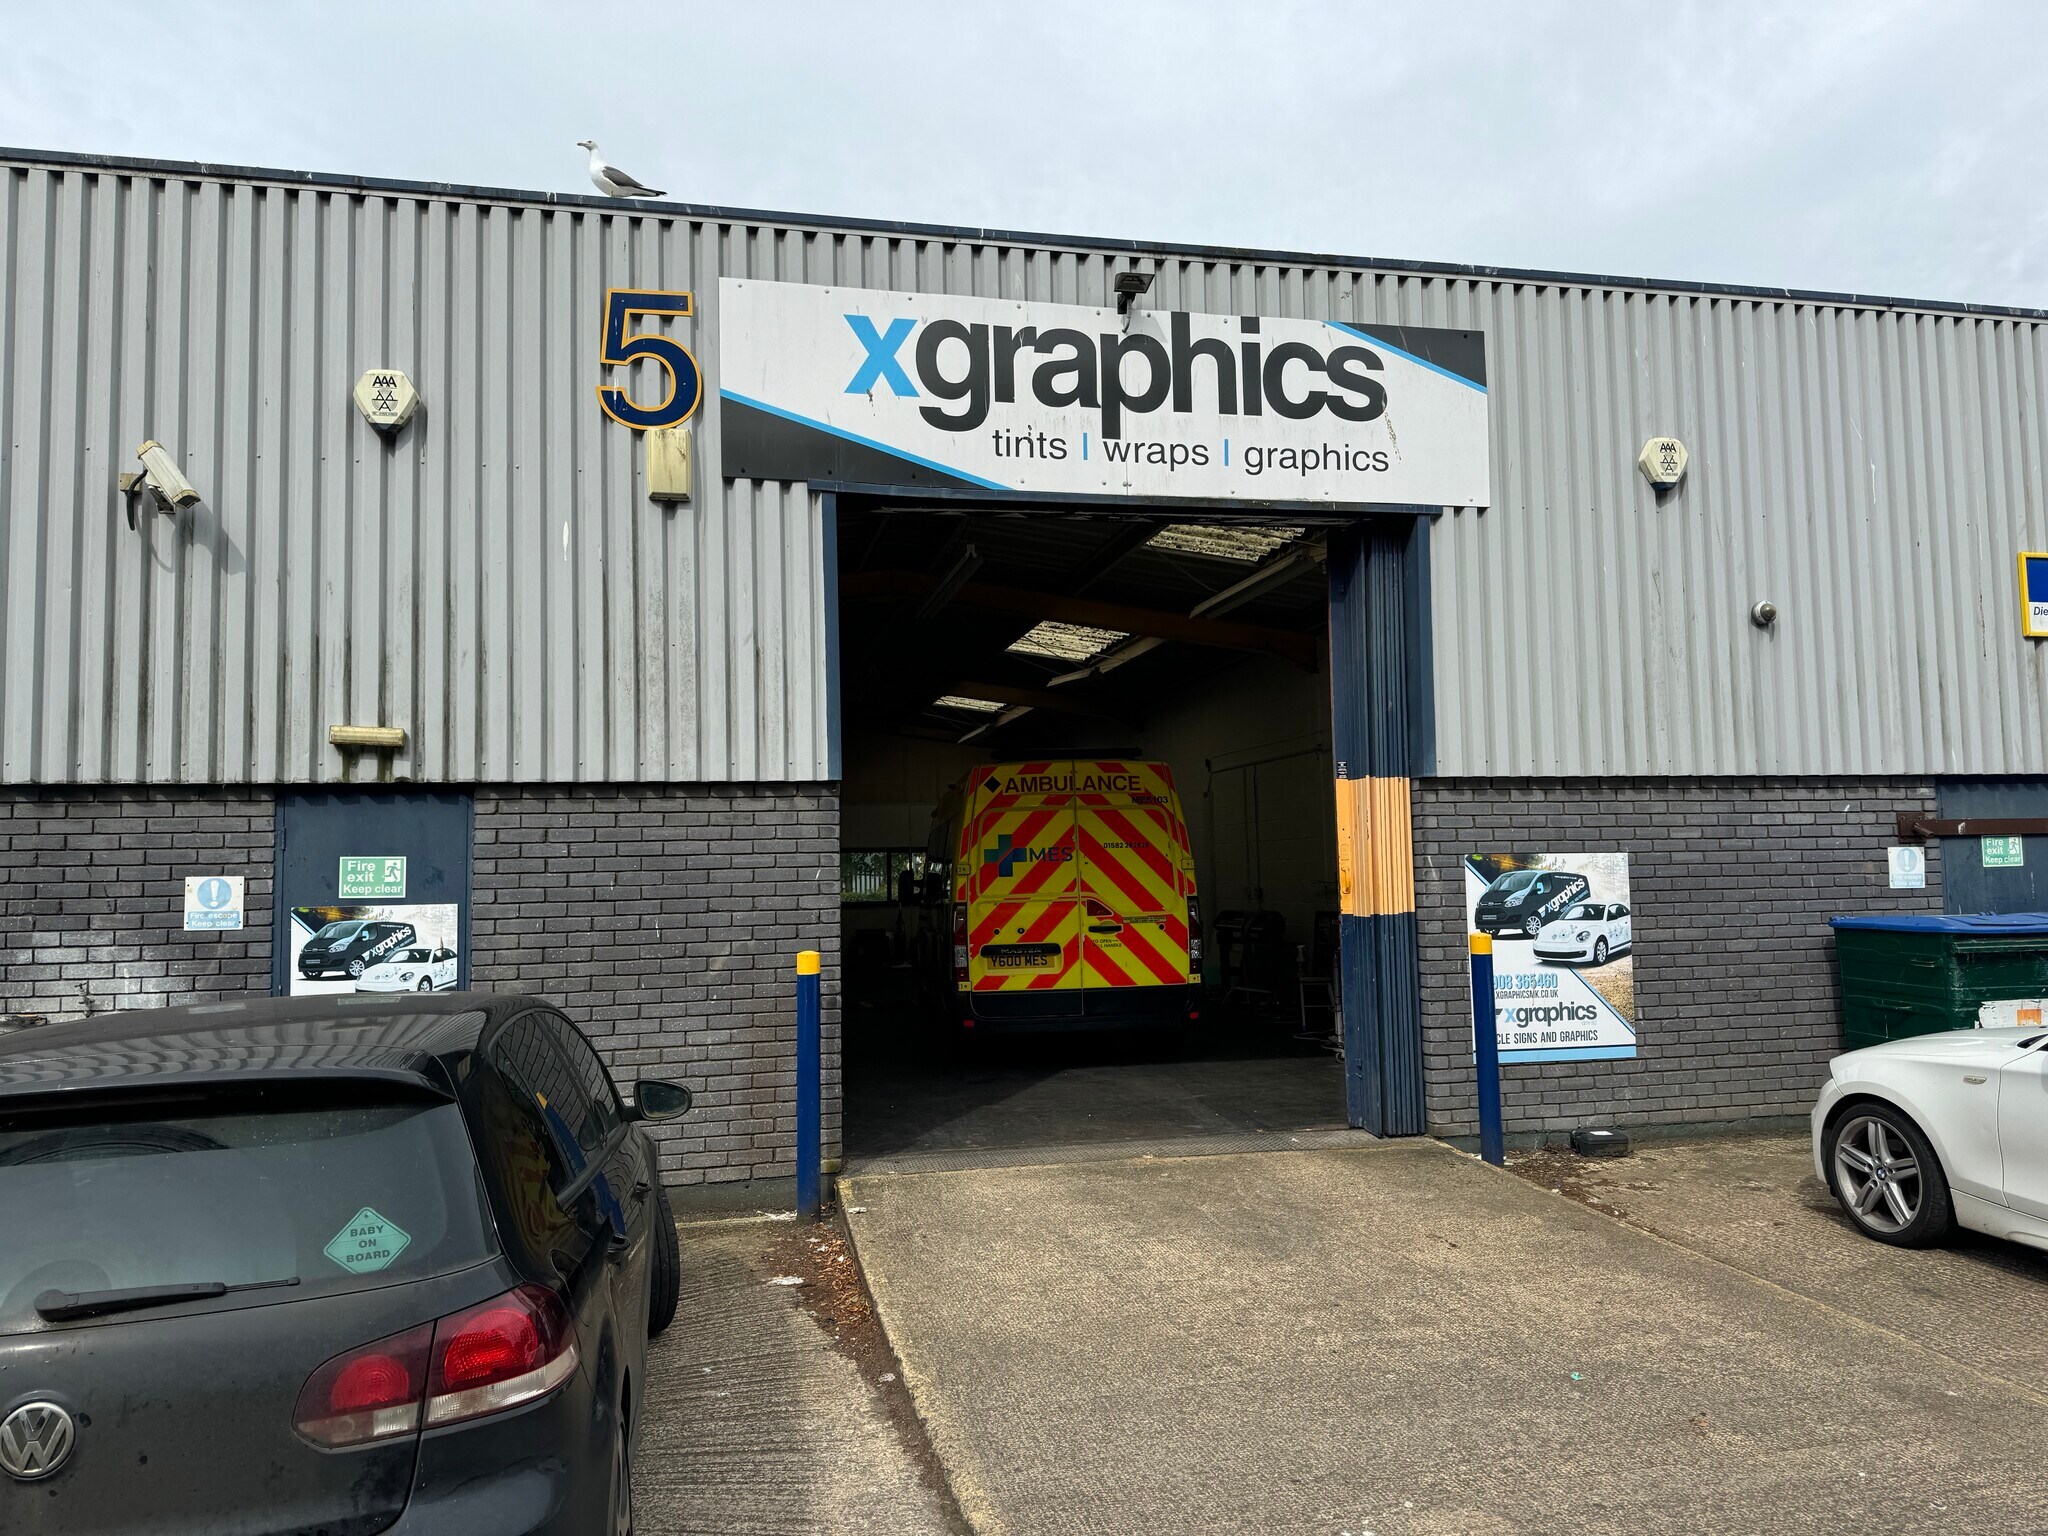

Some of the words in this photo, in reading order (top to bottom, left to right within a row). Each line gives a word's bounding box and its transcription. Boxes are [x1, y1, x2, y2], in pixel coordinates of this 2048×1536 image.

[595, 288, 702, 430] 5
[372, 375, 397, 388] AAA
[843, 311, 1388, 440] xgraphics
[992, 429, 1068, 460] tints
[1103, 440, 1210, 472] wraps
[1244, 443, 1389, 477] graphics
[1003, 774, 1142, 793] AMBULANCE
[1986, 838, 2004, 846] Fire
[1029, 846, 1073, 863] MES
[1986, 846, 2004, 854] exit
[347, 860, 376, 872] Fire
[1985, 856, 2003, 864] Keep
[347, 871, 375, 882] exit
[343, 884, 372, 895] Keep
[374, 884, 402, 893] clear
[1545, 878, 1586, 913] xgraphics
[207, 912, 238, 920] escape
[370, 926, 412, 957] xgraphics
[991, 956, 1022, 967] Y600
[1025, 955, 1048, 966] MES
[1515, 973, 1559, 990] 365460
[1504, 1001, 1598, 1028] xgraphics
[1513, 1032, 1538, 1044] SIGNS
[1540, 1032, 1557, 1043] AND
[1560, 1030, 1598, 1043] GRAPHICS
[350, 1225, 384, 1237] BABY
[358, 1239, 377, 1249] ON
[346, 1250, 390, 1263] BOARD
